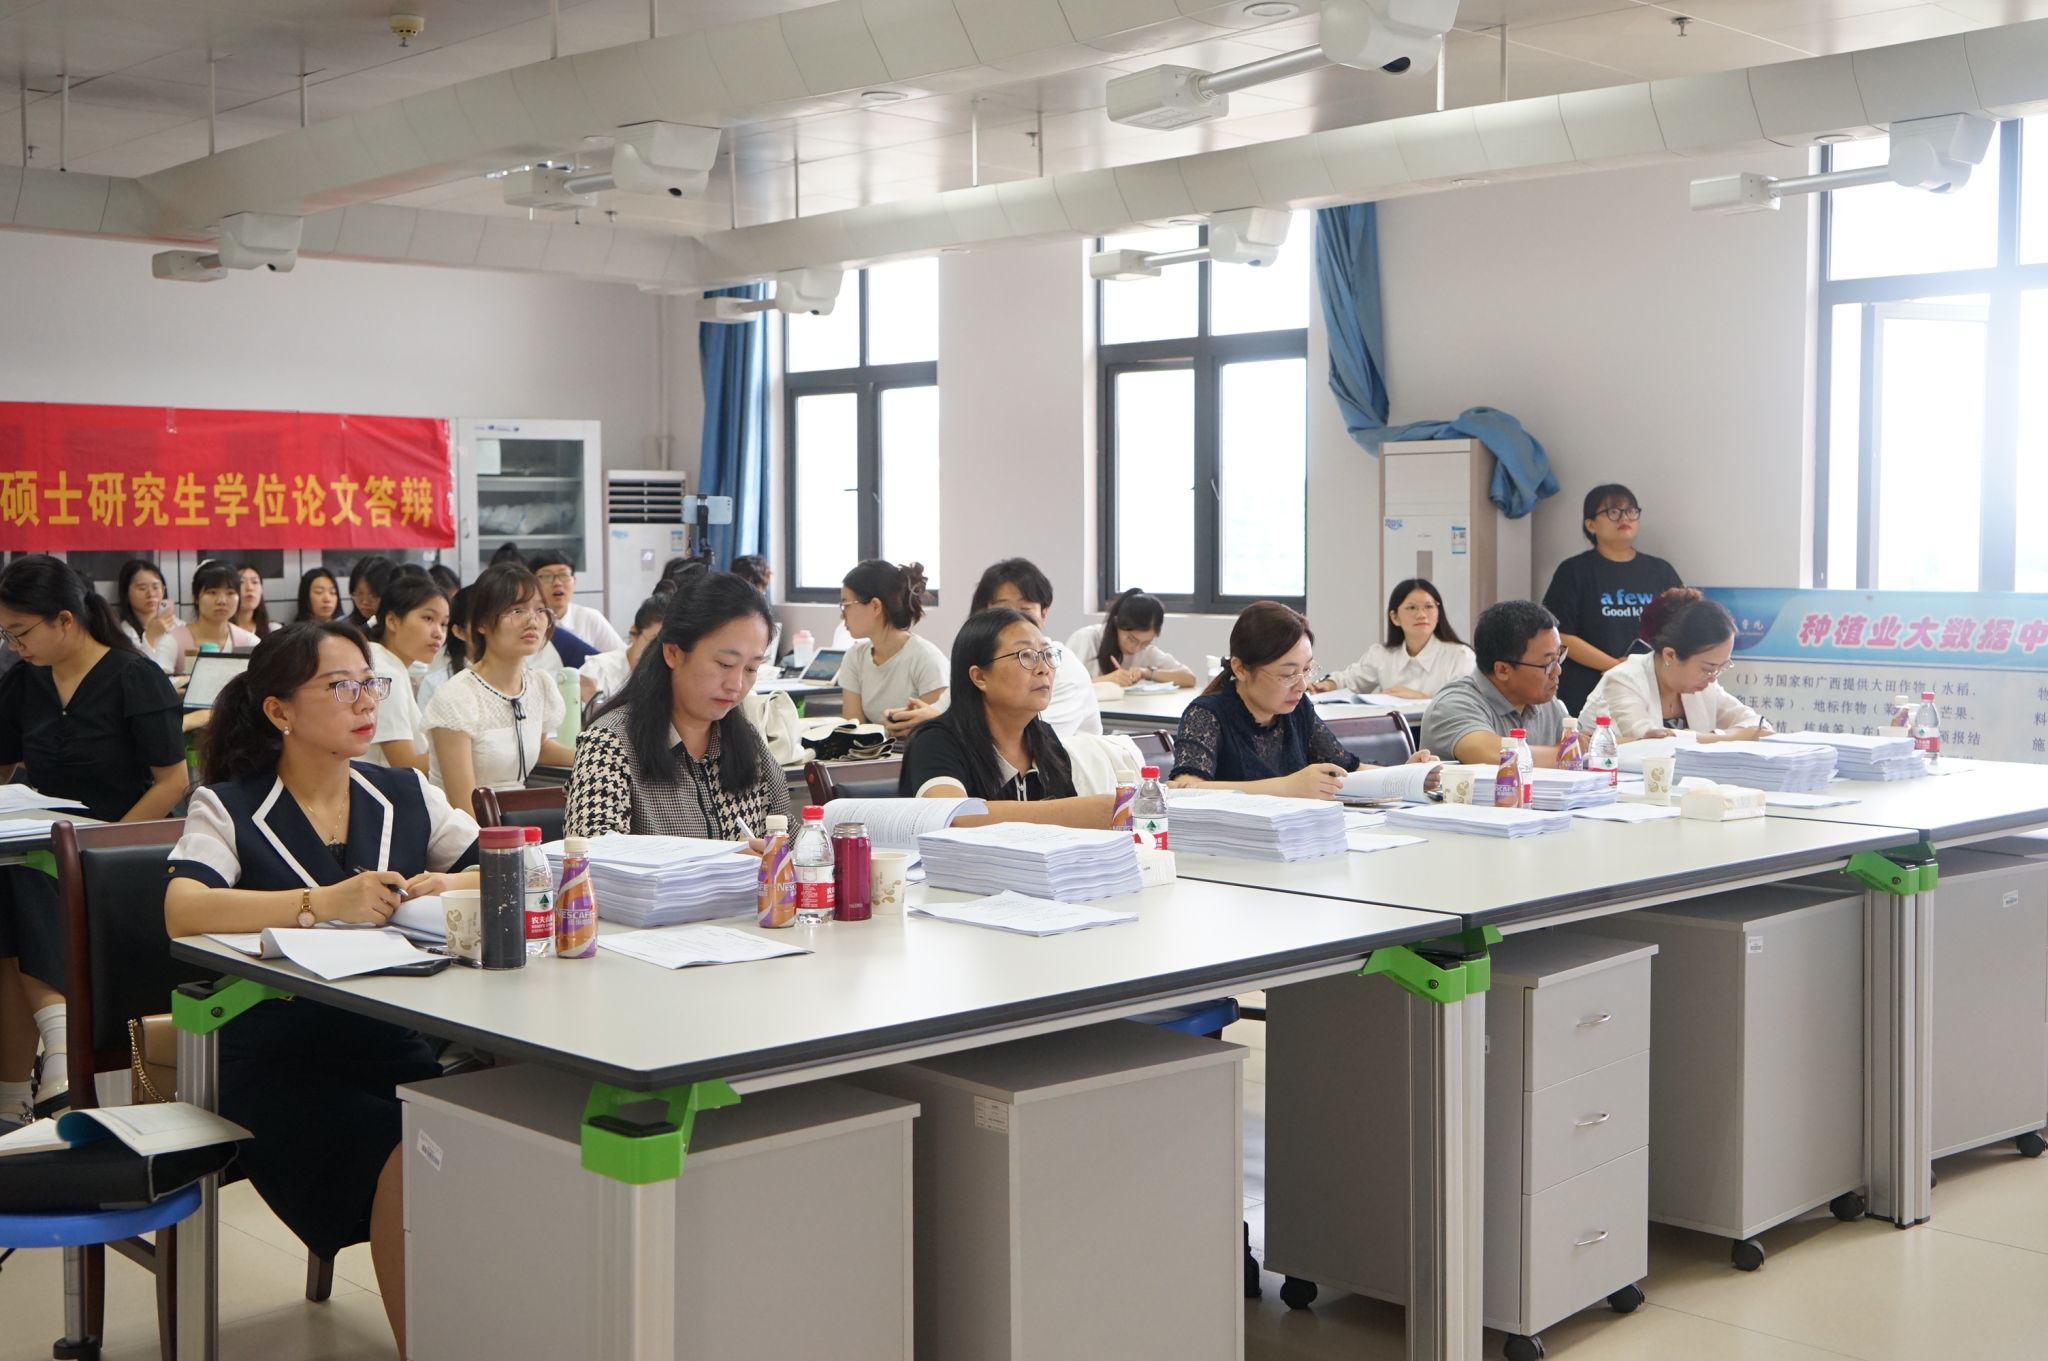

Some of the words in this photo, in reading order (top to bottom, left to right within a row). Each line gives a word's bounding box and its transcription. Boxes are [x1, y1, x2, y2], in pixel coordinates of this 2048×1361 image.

[0, 470, 433, 528] 硕士研究生学位论文答辩
[1600, 592, 1614, 605] a
[1616, 588, 1654, 605] few
[1601, 606, 1631, 617] Good
[1798, 613, 2048, 654] 种植业大数据中
